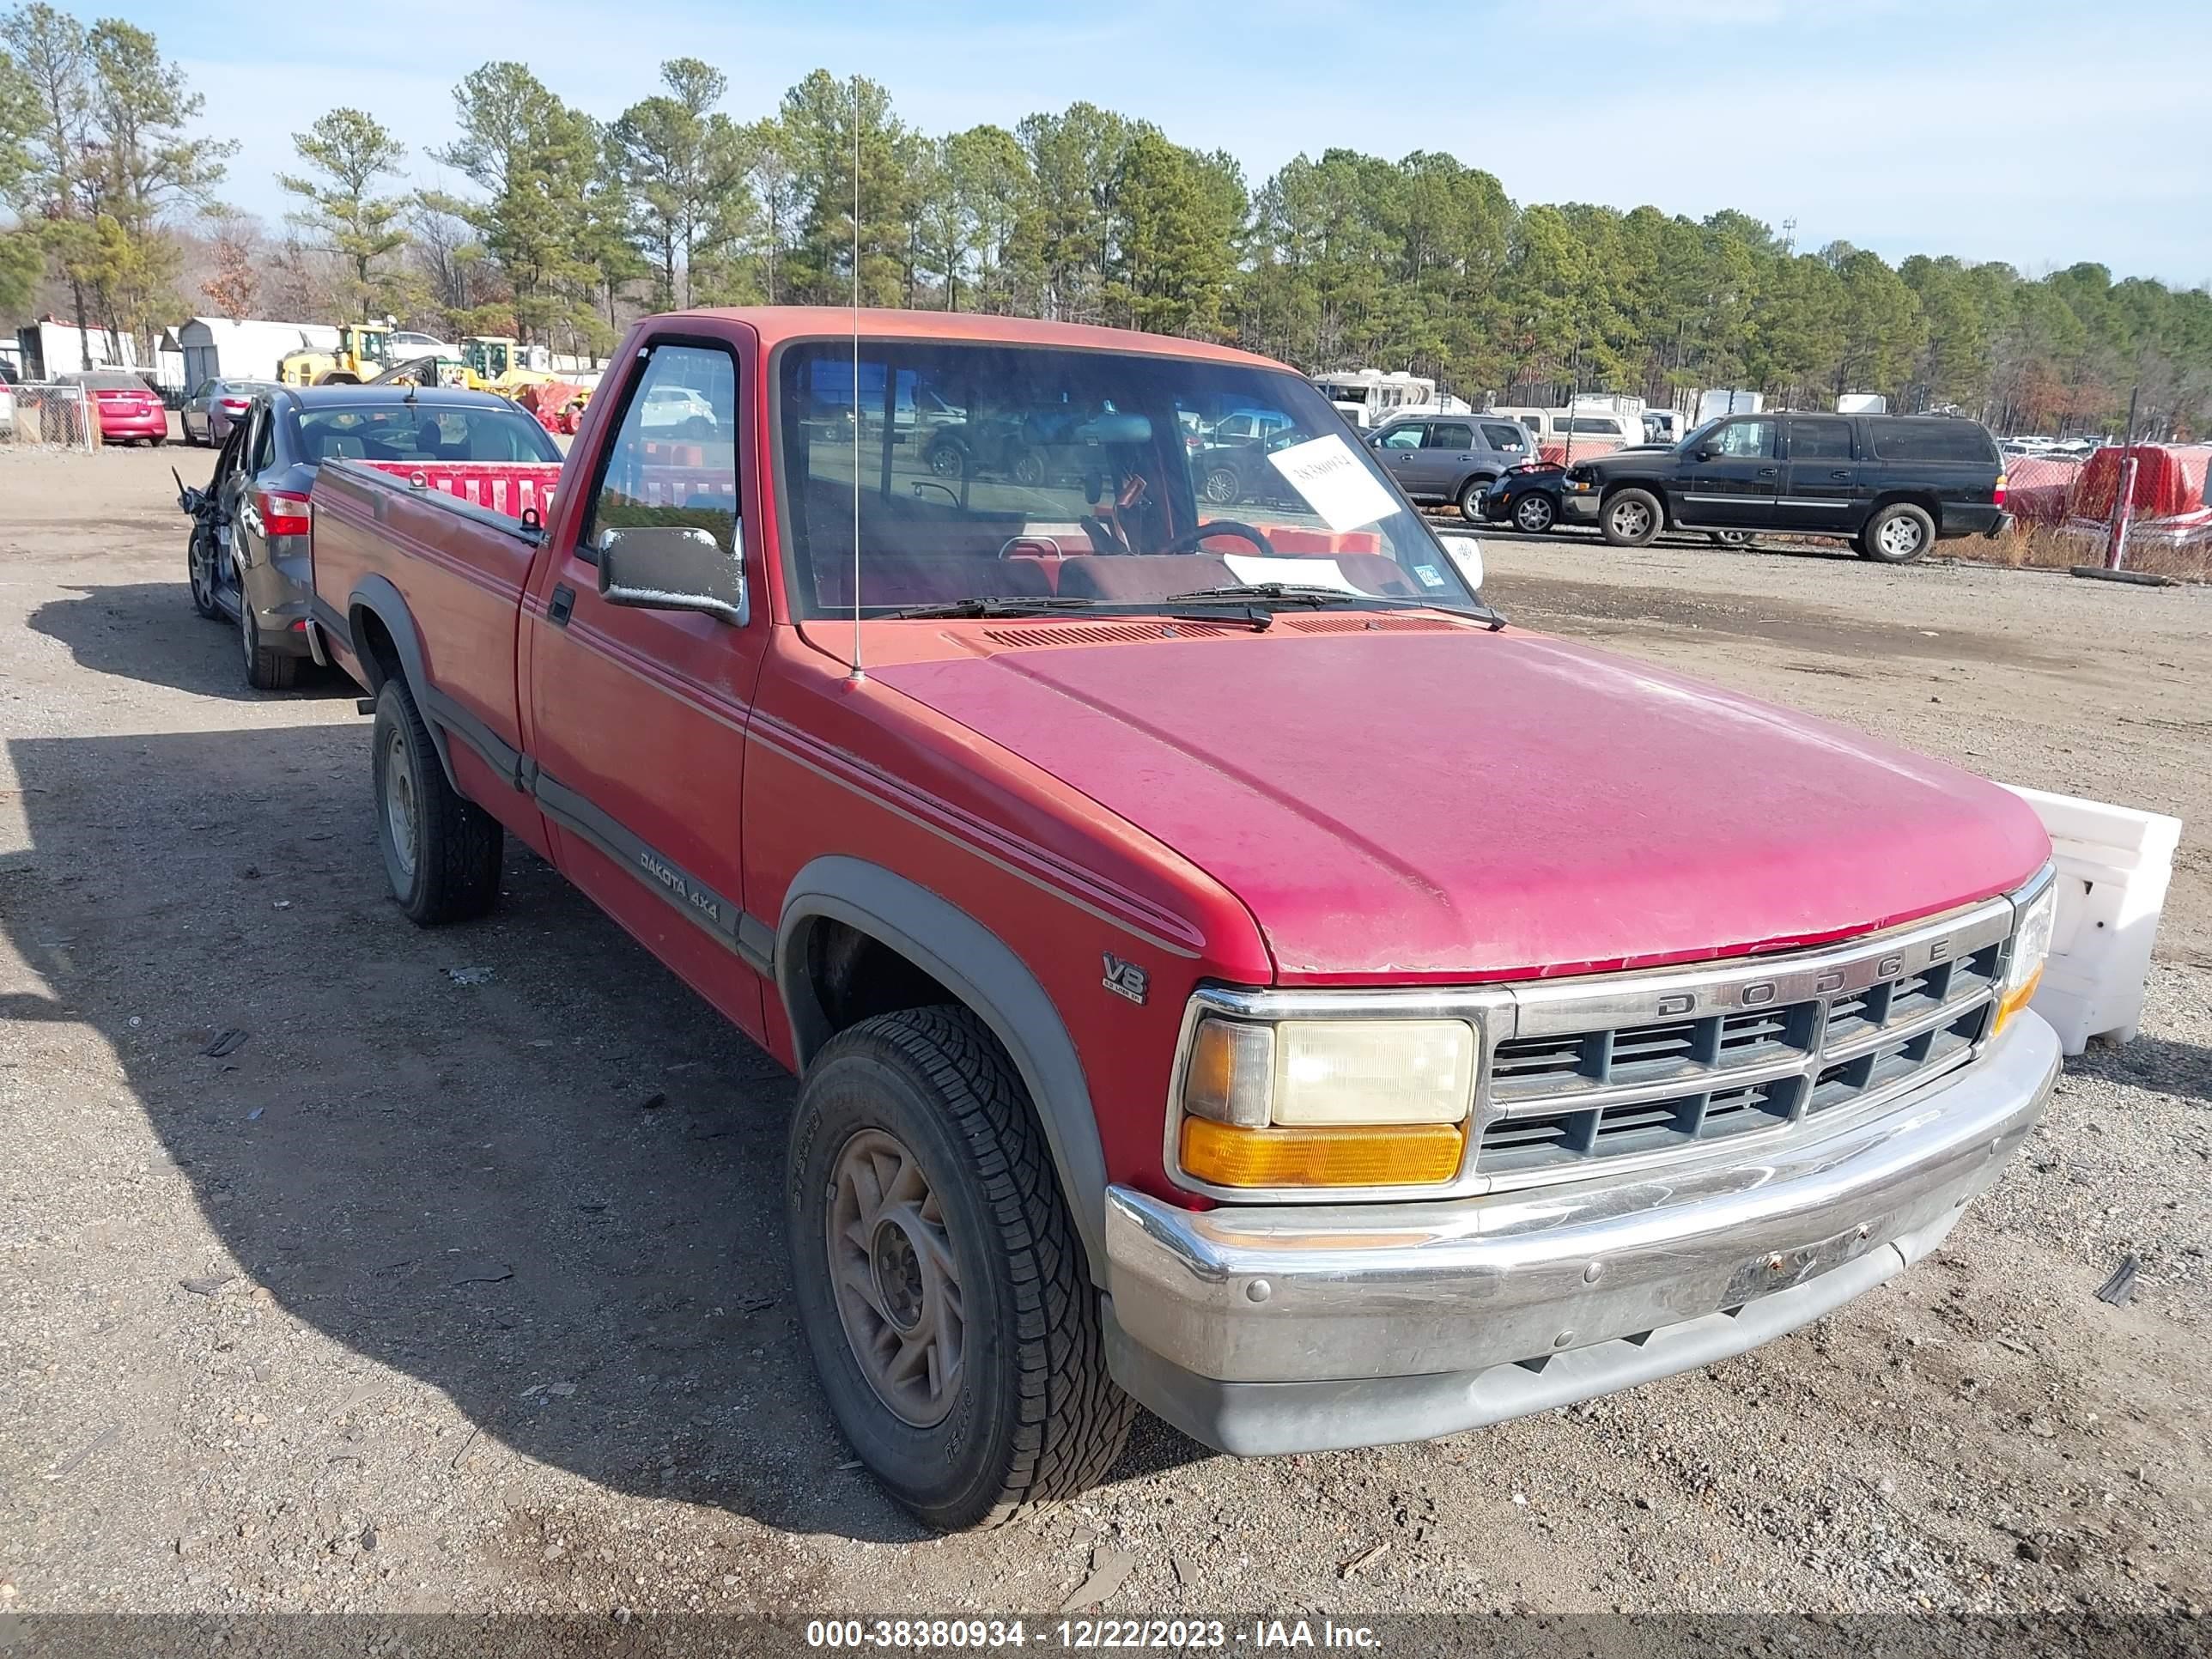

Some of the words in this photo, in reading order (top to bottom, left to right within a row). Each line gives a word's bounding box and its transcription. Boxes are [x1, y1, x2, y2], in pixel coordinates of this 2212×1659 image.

[640, 852, 688, 898] DAKOTA
[1103, 953, 1145, 994] V8
[1656, 939, 1950, 1018] DODGE
